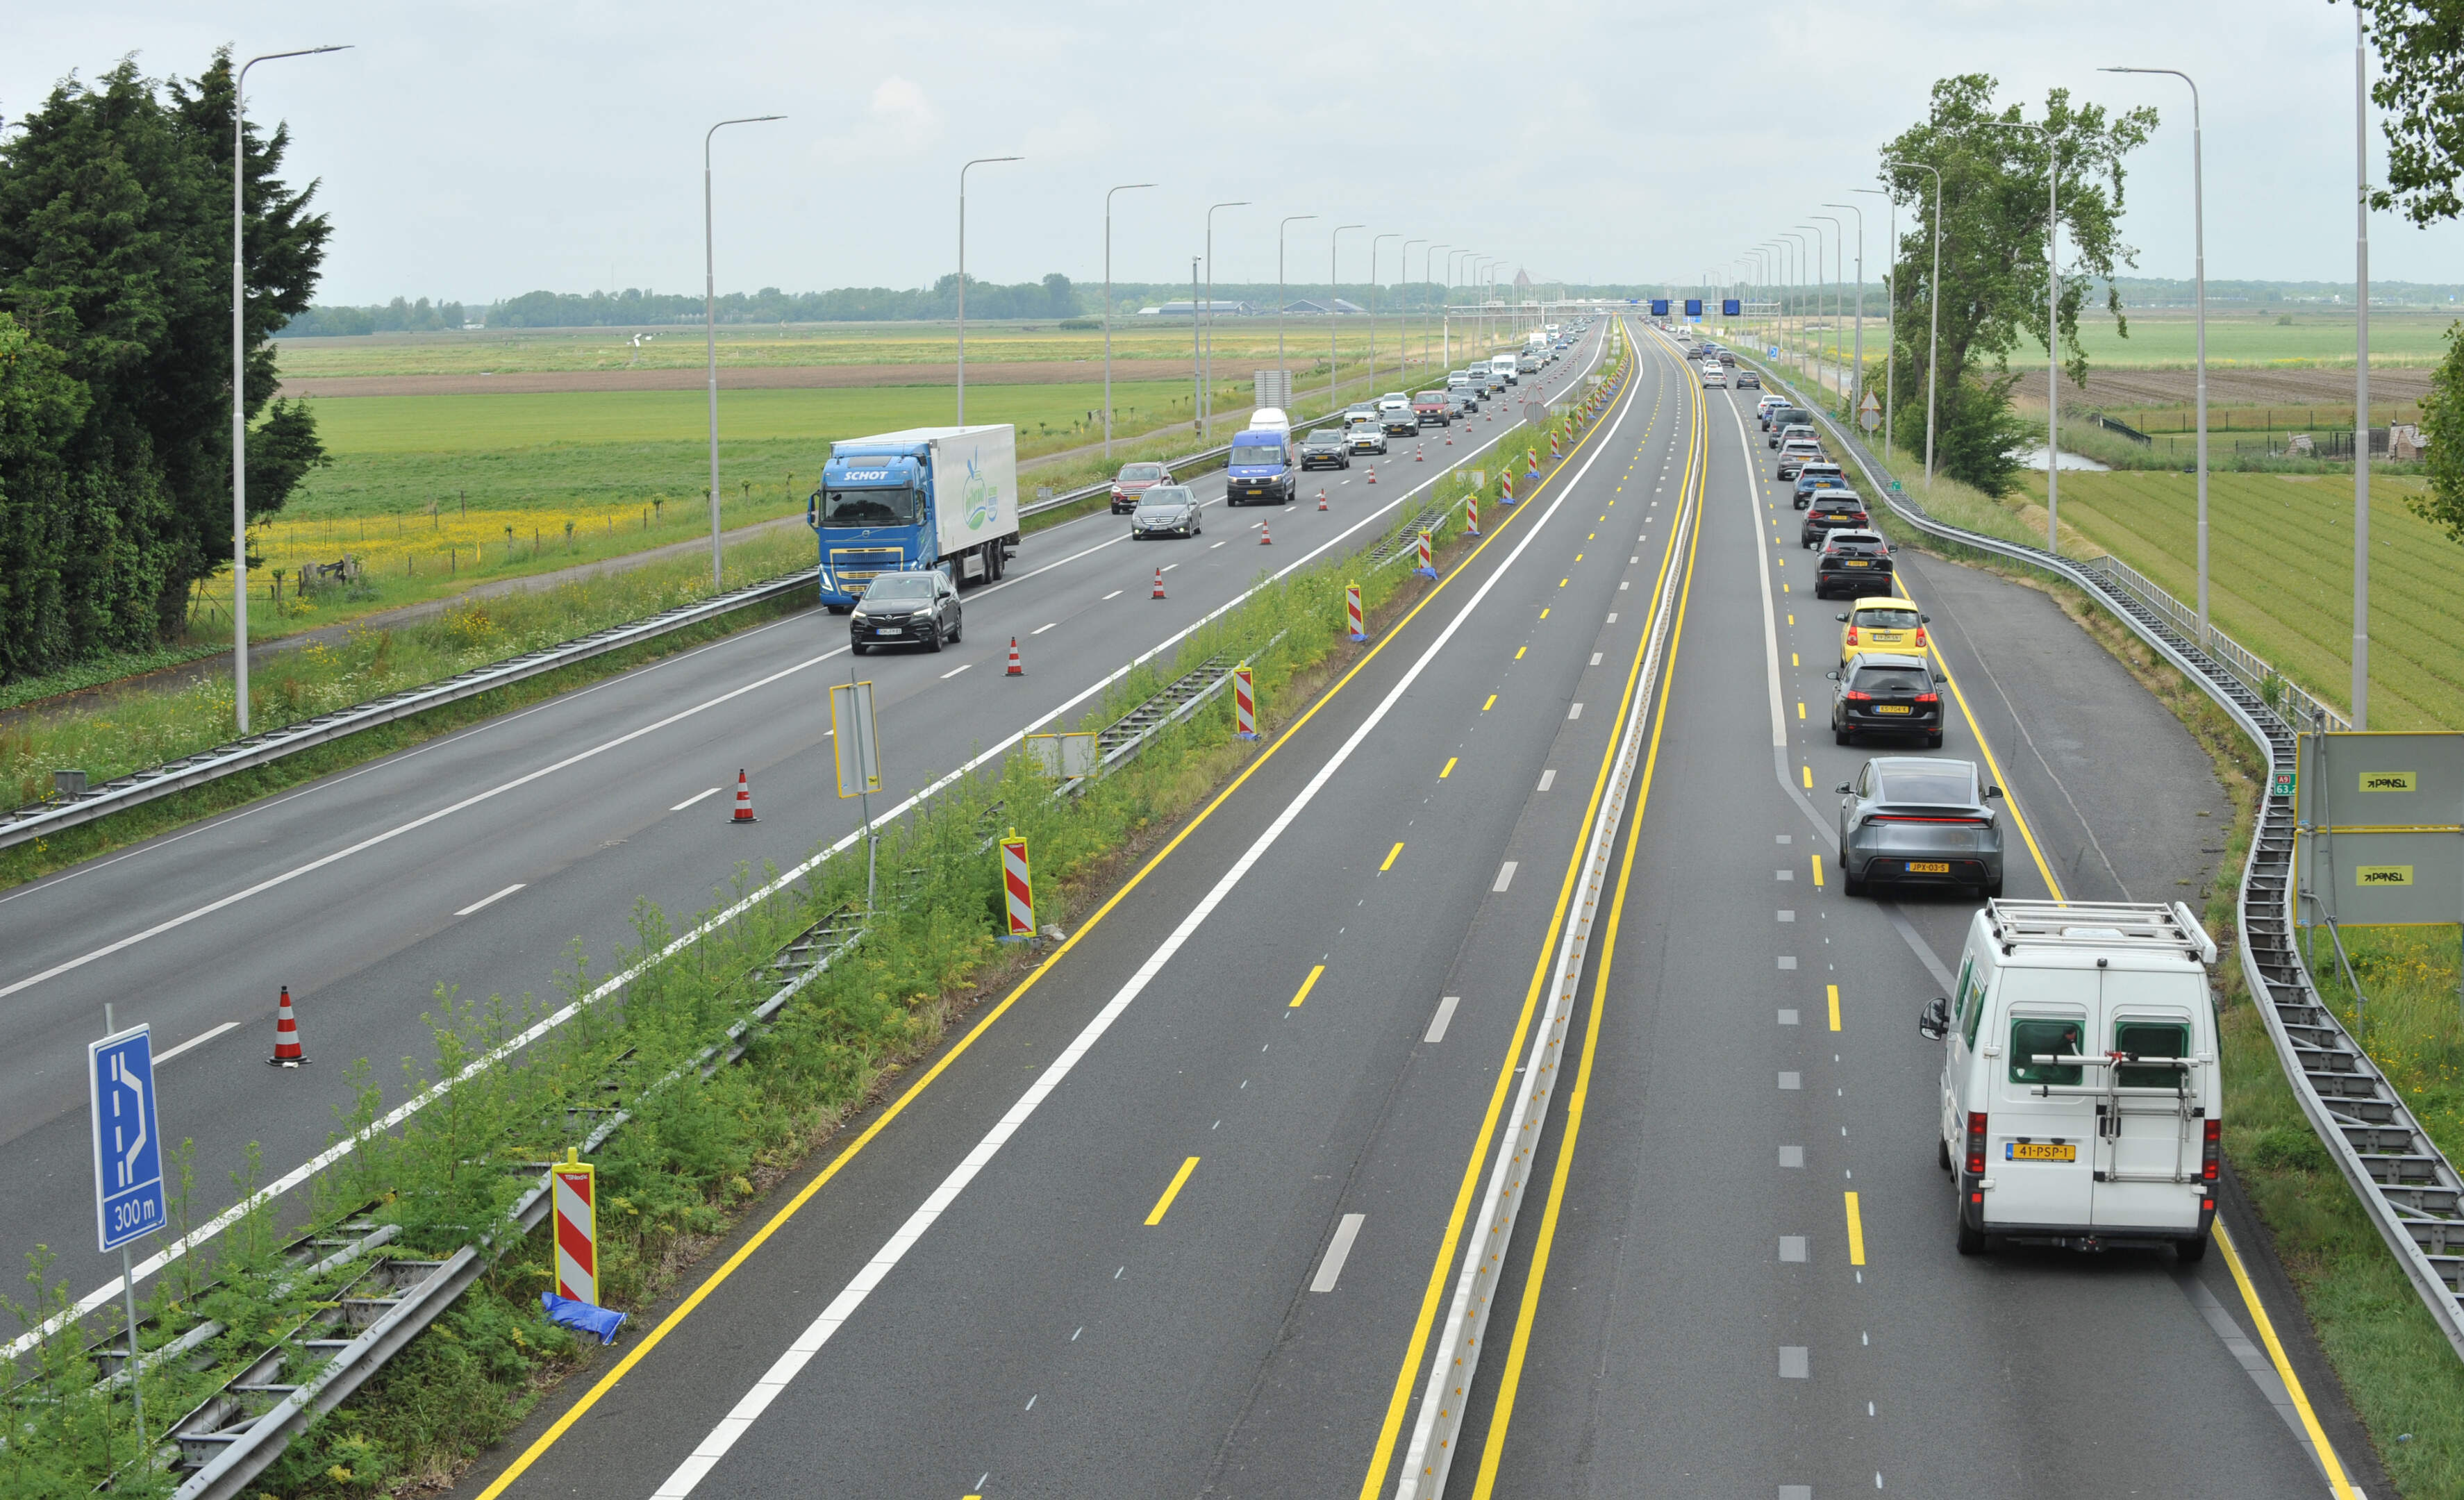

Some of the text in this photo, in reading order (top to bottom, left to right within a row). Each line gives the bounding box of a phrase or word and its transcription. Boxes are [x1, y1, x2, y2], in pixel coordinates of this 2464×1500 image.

[844, 471, 888, 481] SCHOT
[1913, 863, 1945, 872] JPX-03-S
[2020, 1146, 2067, 1158] 41-PSP-1
[115, 1198, 155, 1232] 300 m
